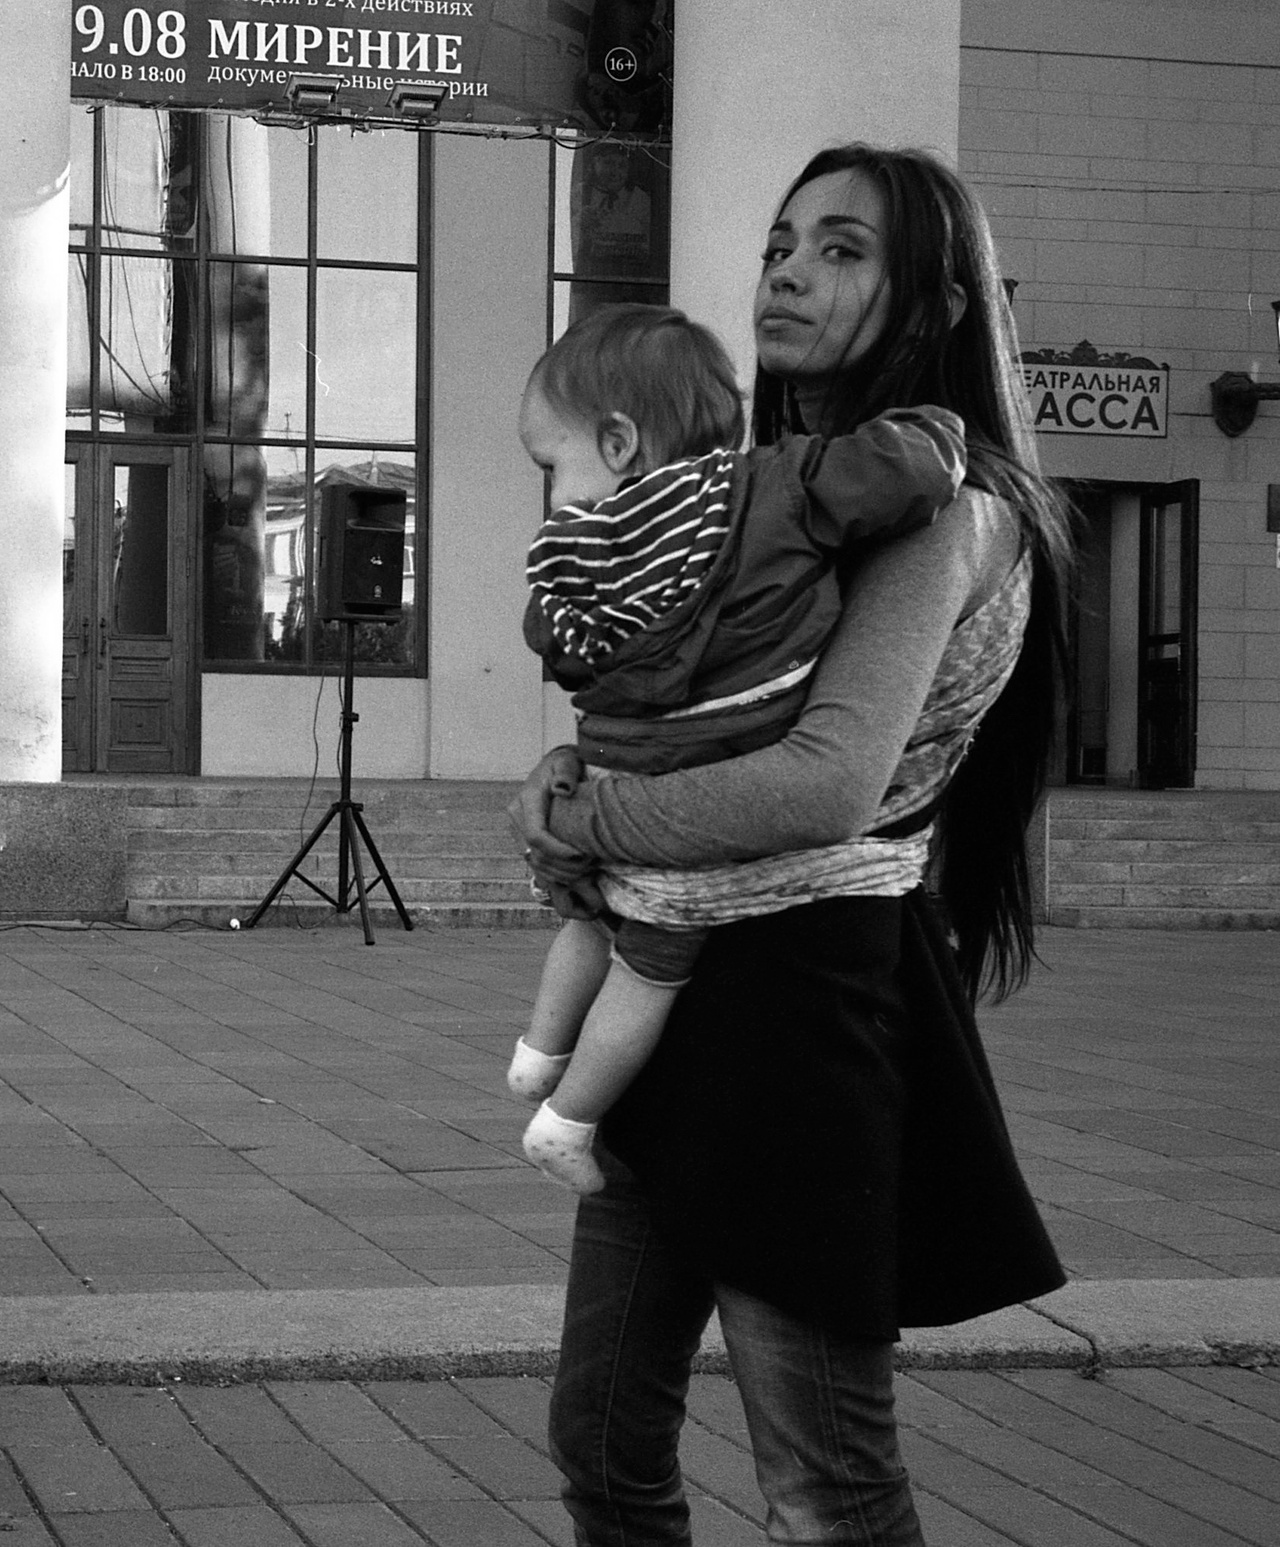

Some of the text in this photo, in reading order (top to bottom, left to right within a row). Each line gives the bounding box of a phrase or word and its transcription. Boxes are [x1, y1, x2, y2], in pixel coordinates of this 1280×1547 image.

[75, 4, 186, 59] 9.08
[208, 19, 463, 74] МИРЕНИЕ
[138, 65, 186, 84] 18:00
[610, 57, 635, 71] 16+
[207, 66, 394, 91] докумеьные
[1023, 370, 1160, 394] ЕАТРАЛЬНАЯ
[1029, 391, 1160, 431] АССА
